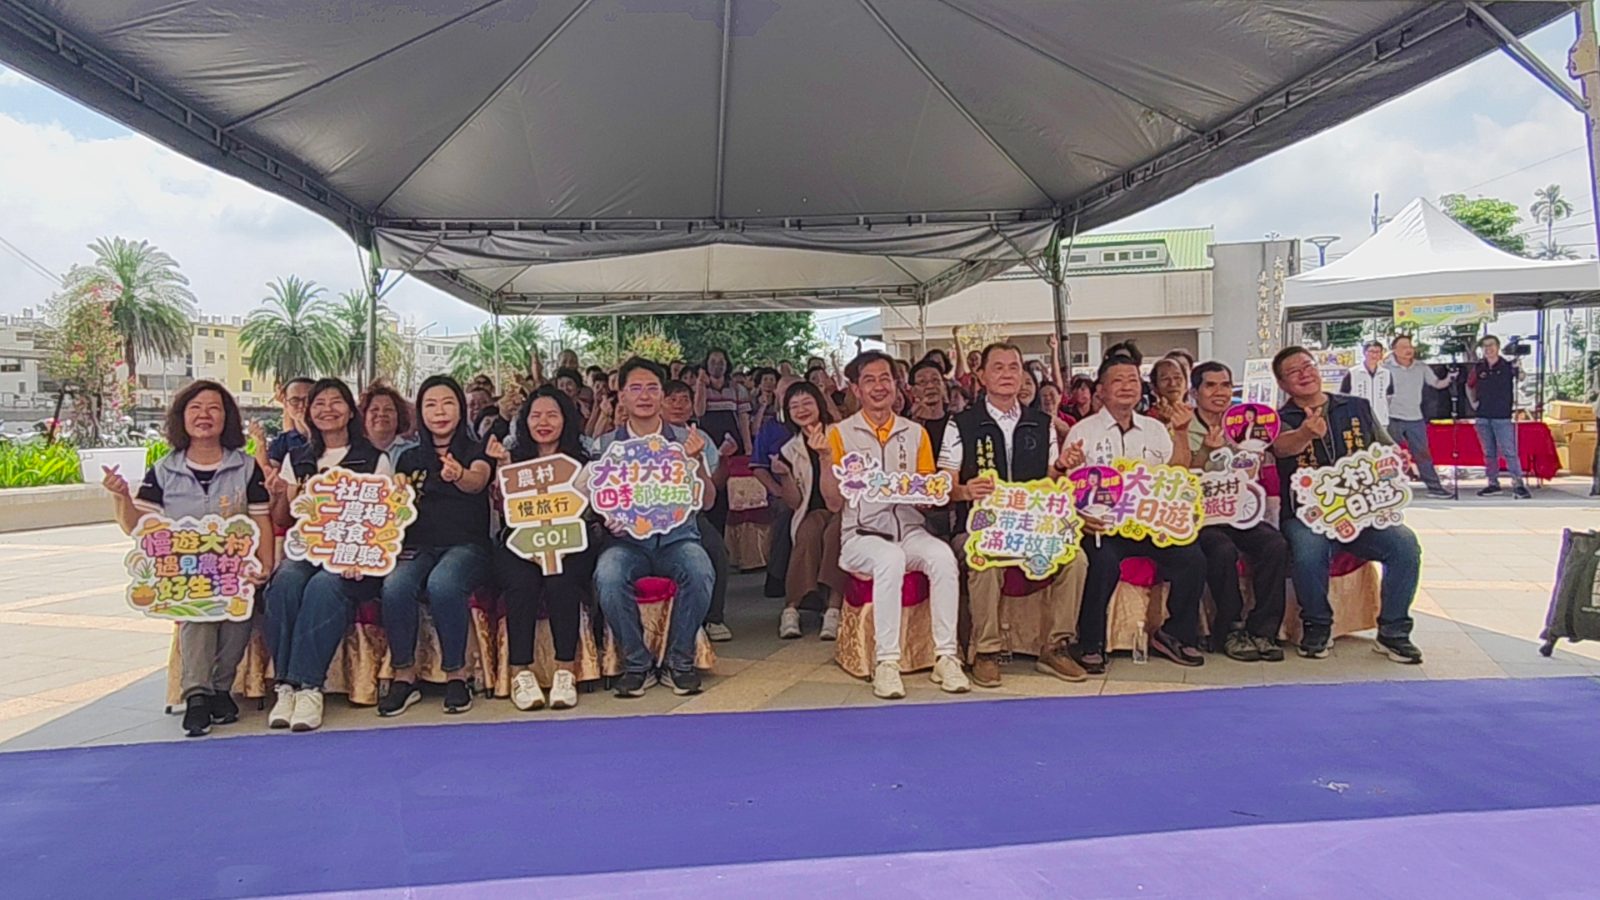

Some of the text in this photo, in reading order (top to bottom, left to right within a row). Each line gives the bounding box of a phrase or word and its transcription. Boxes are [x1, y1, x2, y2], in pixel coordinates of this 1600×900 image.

[517, 464, 554, 488] 農村
[869, 473, 948, 499] 大村大好
[1125, 467, 1184, 501] 大村
[1315, 459, 1375, 506] 大村
[518, 496, 569, 517] 慢旅行
[1111, 493, 1191, 534] 半日遊
[1324, 481, 1405, 524] 一日遊
[142, 529, 253, 557] 慢遊大村
[532, 528, 568, 547] GO!
[980, 530, 1062, 554] 滿好故事
[155, 553, 242, 577] 遇見農村
[312, 542, 388, 569] 一體驗
[156, 573, 239, 601] 好生活
